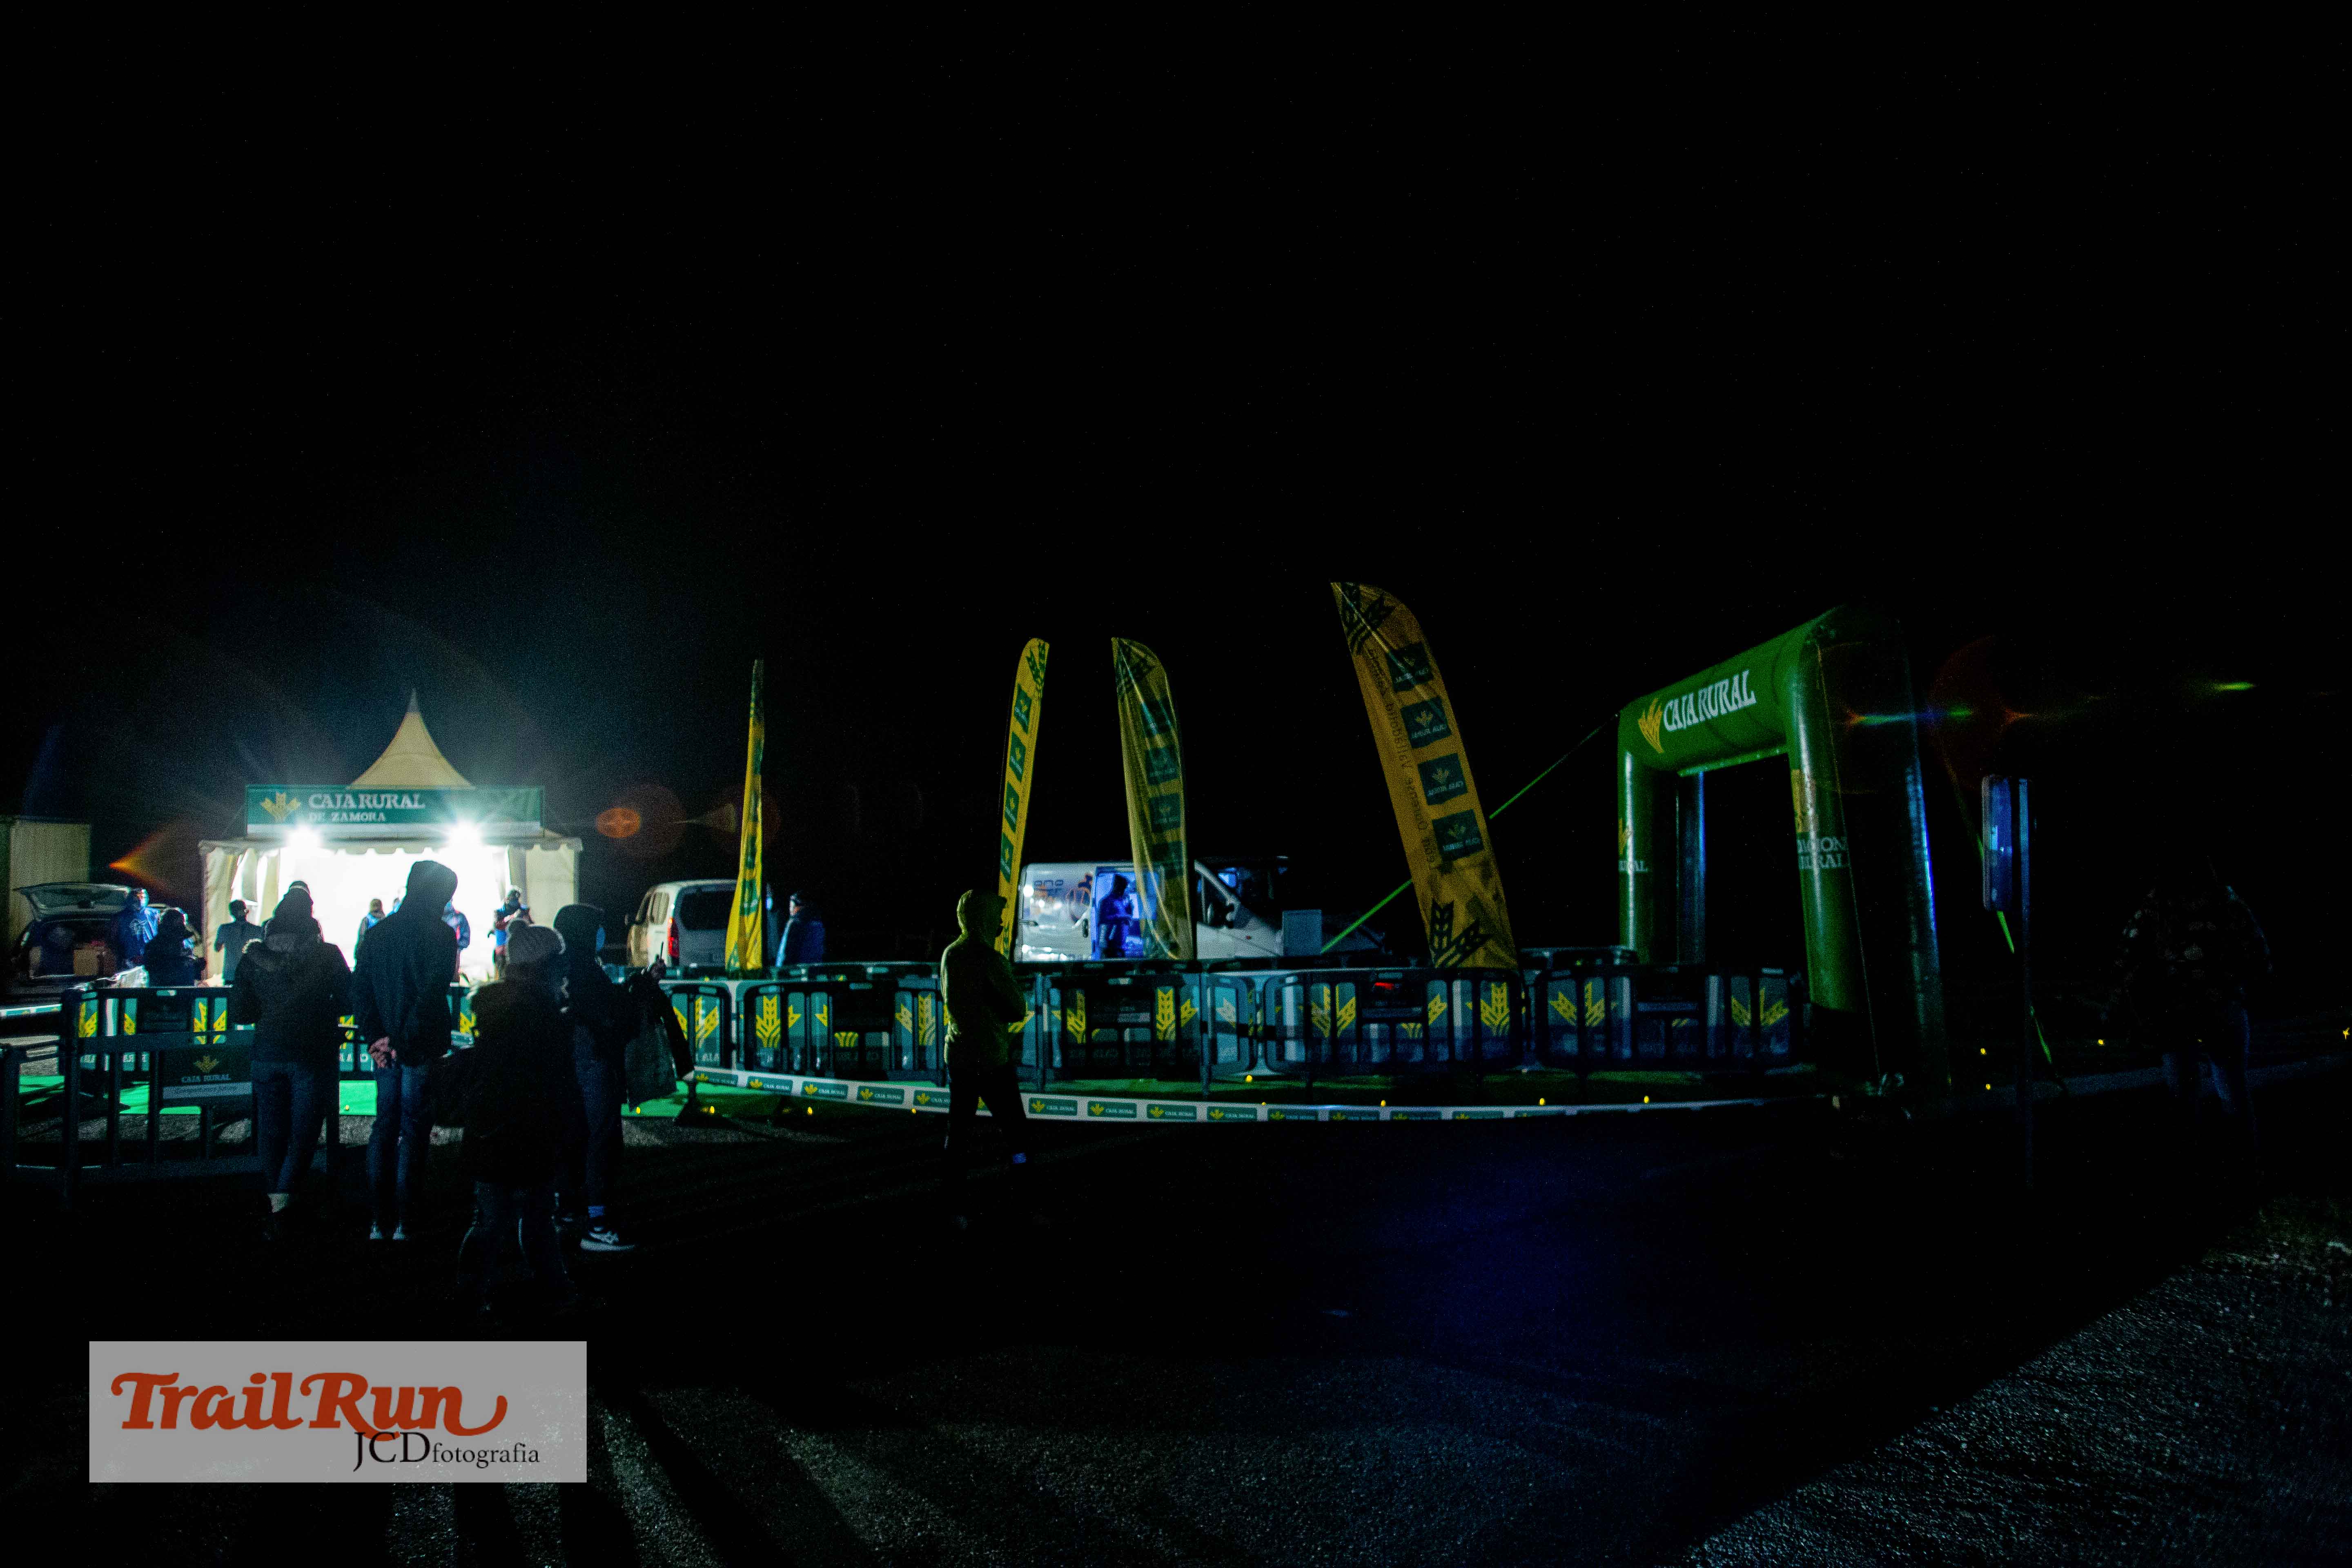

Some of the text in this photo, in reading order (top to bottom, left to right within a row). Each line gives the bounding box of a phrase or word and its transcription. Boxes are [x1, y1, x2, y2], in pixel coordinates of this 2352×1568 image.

[1663, 668, 1757, 732] CAJA RURAL
[308, 793, 425, 809] CAJA RURAL
[331, 811, 386, 822] ZAMORA
[180, 1074, 232, 1083] CAJA RURAL
